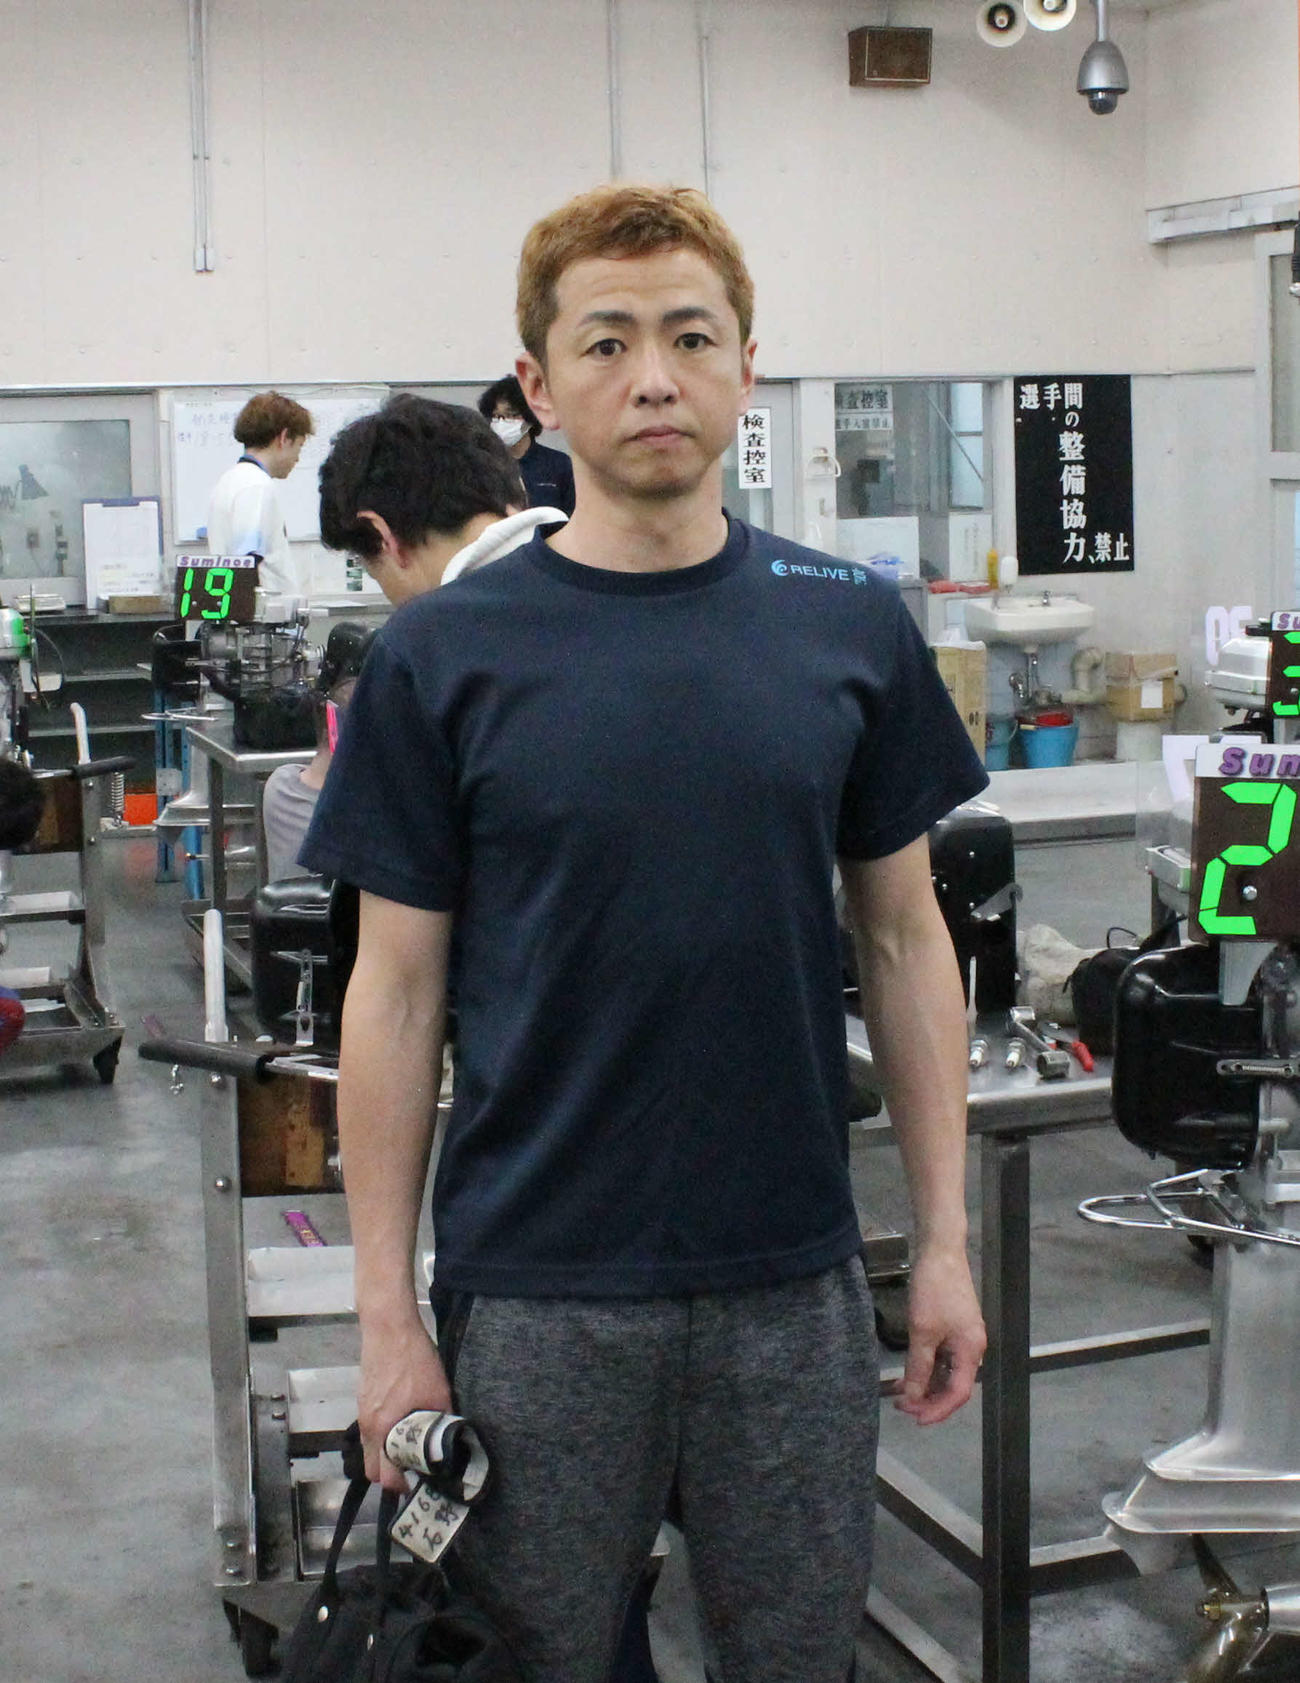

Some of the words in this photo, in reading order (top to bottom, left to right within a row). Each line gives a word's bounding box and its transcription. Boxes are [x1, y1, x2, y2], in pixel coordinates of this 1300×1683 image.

[743, 414, 766, 483] 検査控室
[180, 556, 252, 567] Suminoe
[791, 565, 850, 581] RELIVE
[180, 568, 234, 619] 19
[1198, 782, 1297, 935] 2
